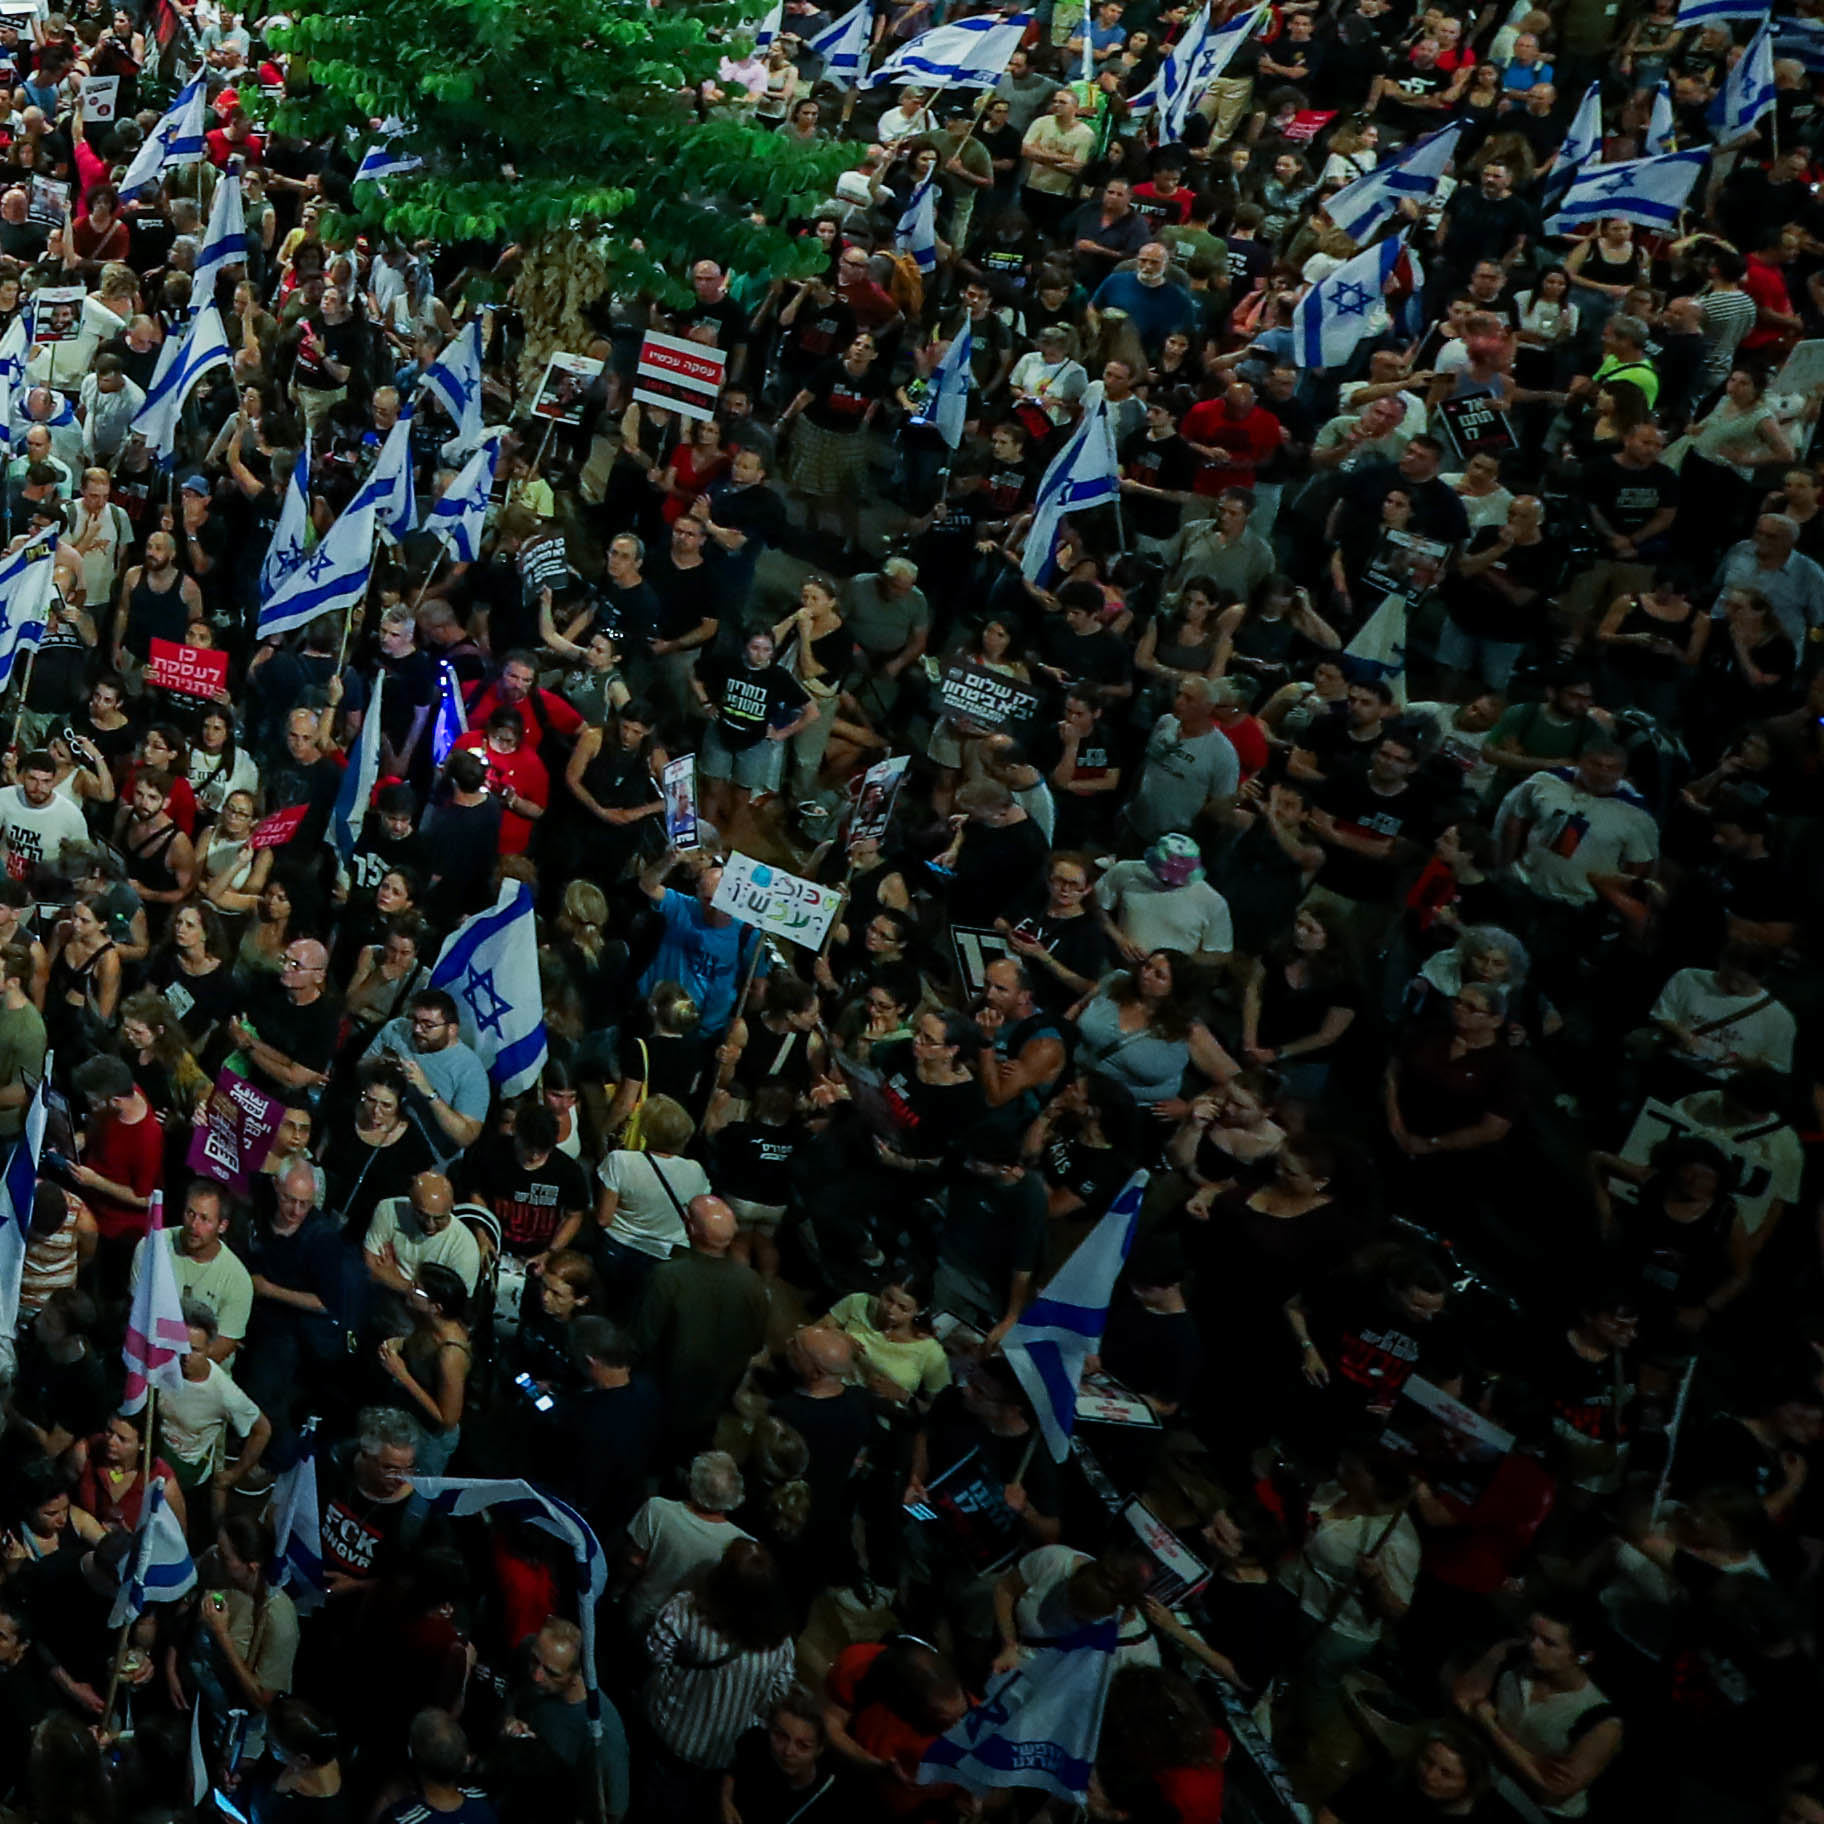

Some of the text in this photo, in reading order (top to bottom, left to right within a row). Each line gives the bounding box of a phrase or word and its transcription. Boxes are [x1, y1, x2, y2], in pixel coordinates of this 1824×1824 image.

[647, 350, 718, 378] עסקה עכשיו
[1462, 397, 1485, 413] אל
[1458, 412, 1495, 426] תתנו
[1463, 427, 1479, 440] לו
[179, 648, 197, 662] כן
[153, 656, 221, 682] לעסקת
[148, 670, 217, 696] נתניהו
[942, 679, 994, 708] ביטחון
[963, 672, 1039, 709] רק שלום
[995, 699, 1034, 719] יביא
[10, 825, 40, 846] אתה
[9, 841, 43, 864] הראש
[326, 1504, 379, 1559] FCK
